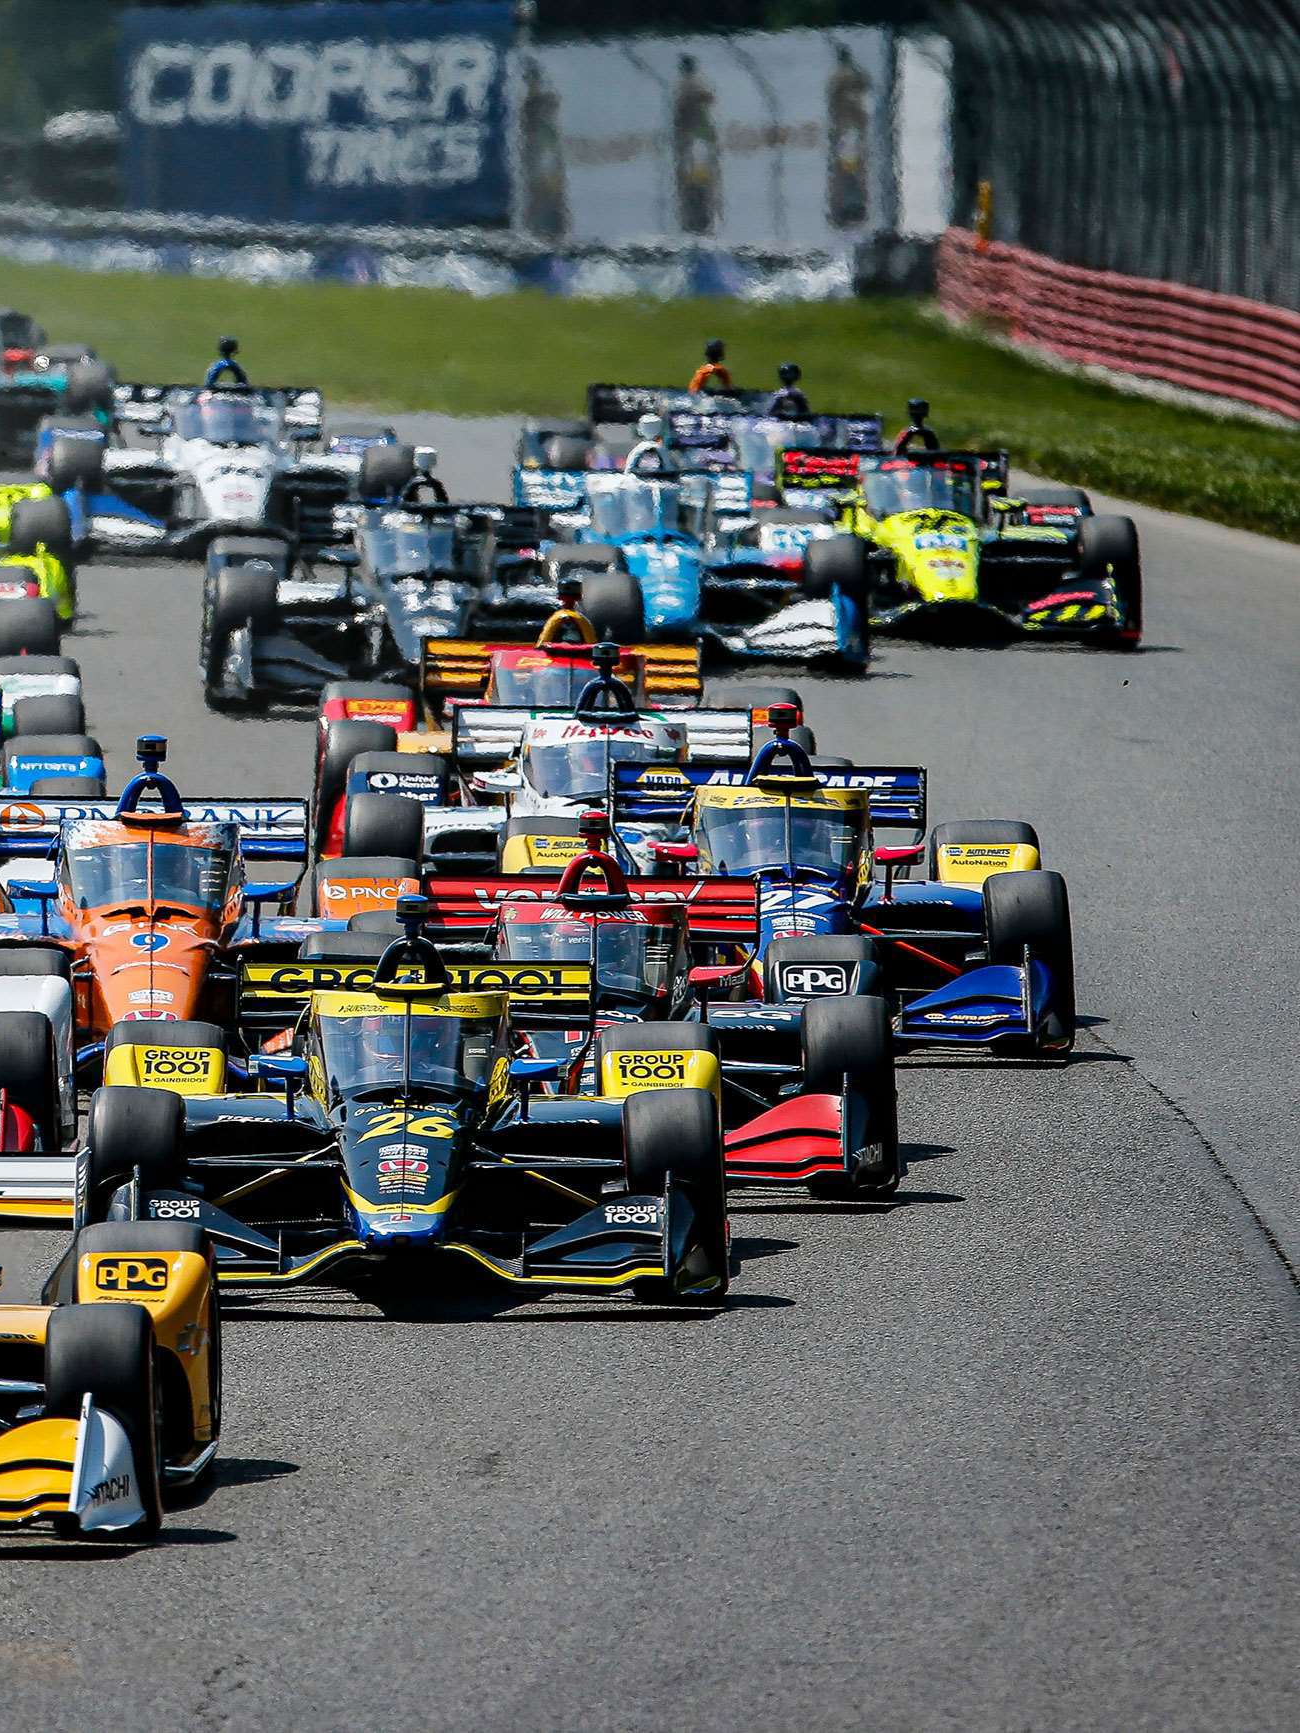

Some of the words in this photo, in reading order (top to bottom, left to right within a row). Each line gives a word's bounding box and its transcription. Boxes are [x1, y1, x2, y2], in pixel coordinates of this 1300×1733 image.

[128, 37, 497, 127] COOPER
[951, 860, 1009, 868] AutoNation
[350, 886, 398, 899] PNC
[760, 889, 835, 912] 27
[539, 908, 573, 920] WILL
[578, 909, 649, 922] POWER
[130, 932, 171, 954] 9
[787, 969, 843, 992] PPG
[710, 1010, 793, 1021] 5G
[144, 1050, 211, 1060] GROUP
[618, 1054, 685, 1065] GROUP
[144, 1061, 210, 1075] 1001
[619, 1065, 685, 1080] 1001
[356, 1111, 455, 1144] 26
[148, 1199, 201, 1208] GROUP
[604, 1205, 658, 1214] GROUP
[150, 1207, 201, 1219] 1001
[604, 1213, 658, 1224] 1001
[97, 1261, 166, 1290] PPG
